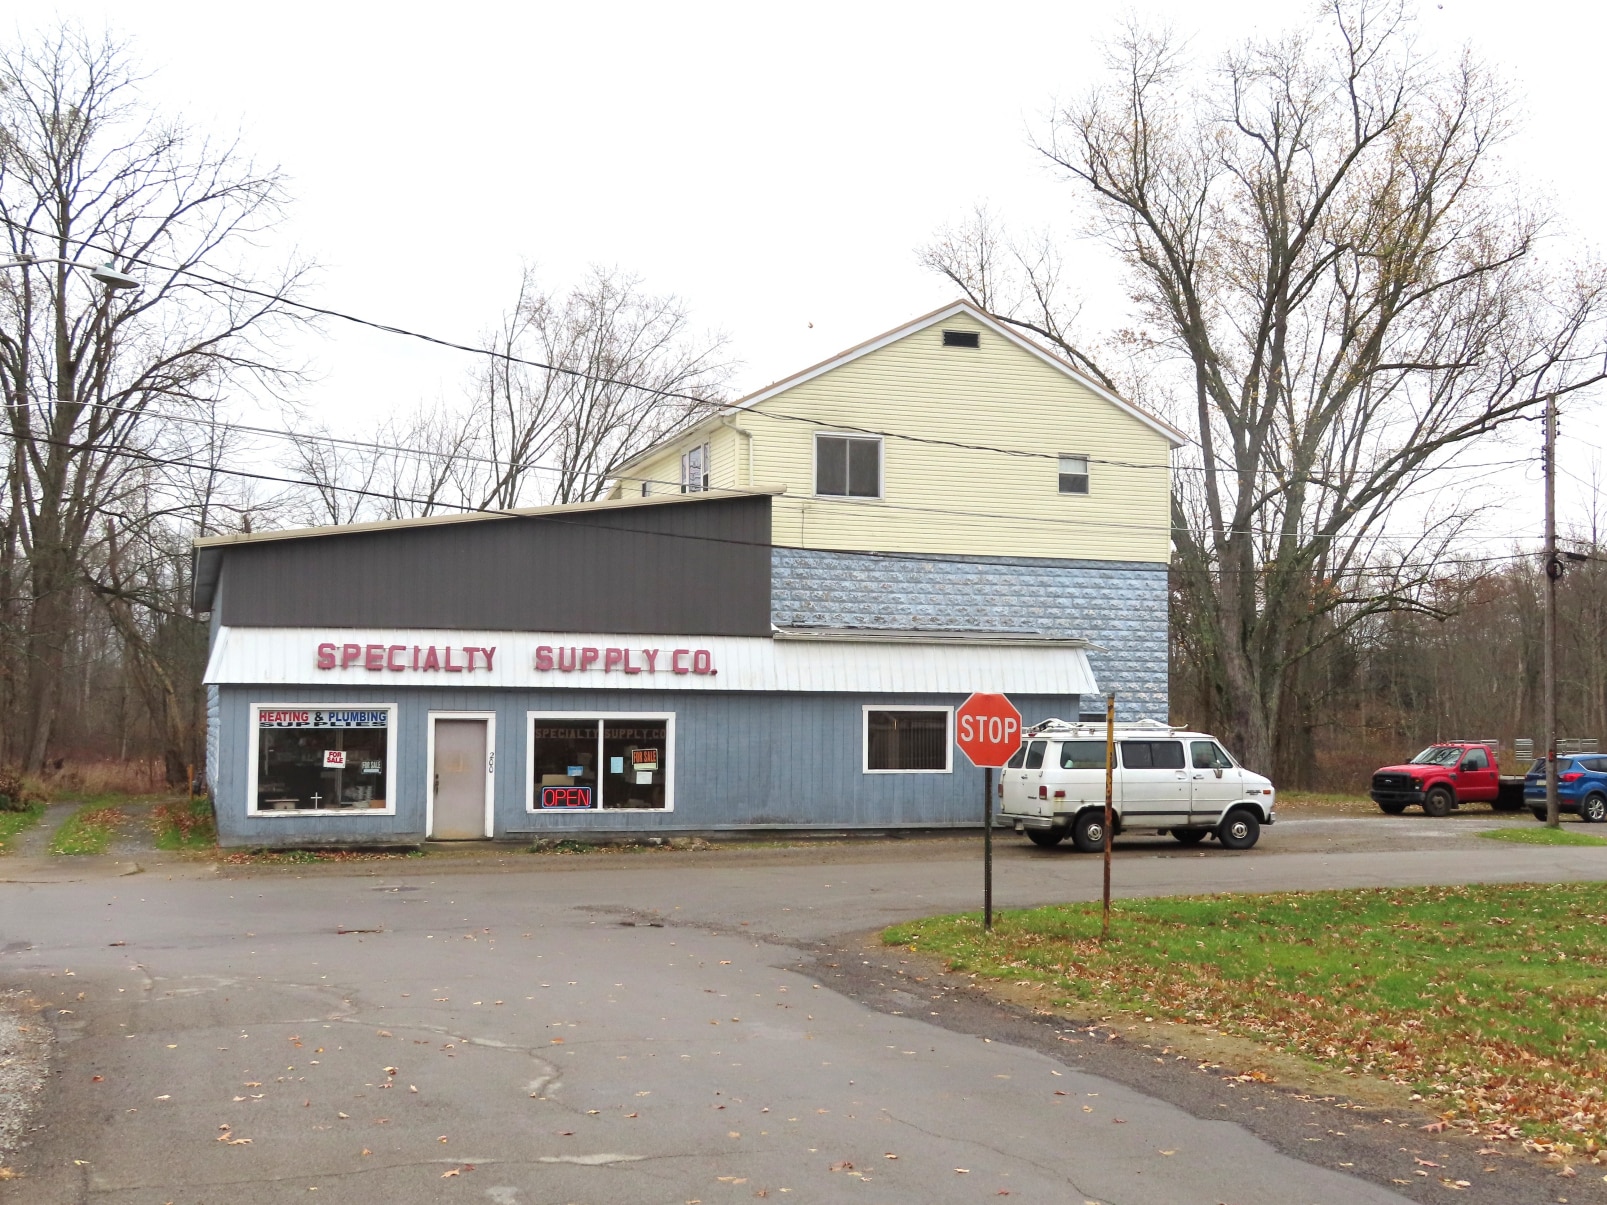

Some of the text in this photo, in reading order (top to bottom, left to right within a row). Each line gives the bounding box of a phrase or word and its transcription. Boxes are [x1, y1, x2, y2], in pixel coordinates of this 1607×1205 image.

[317, 642, 718, 676] SPECIALTY SUPPLY CO.
[259, 711, 387, 722] HEATING & PLUMBING
[535, 728, 599, 739] SPECIALTY
[604, 728, 648, 740] SUPPLY
[960, 714, 1018, 744] STOP
[633, 750, 657, 763] FOR SALE
[361, 760, 381, 769] FOR SALE
[543, 789, 590, 807] OPEN
